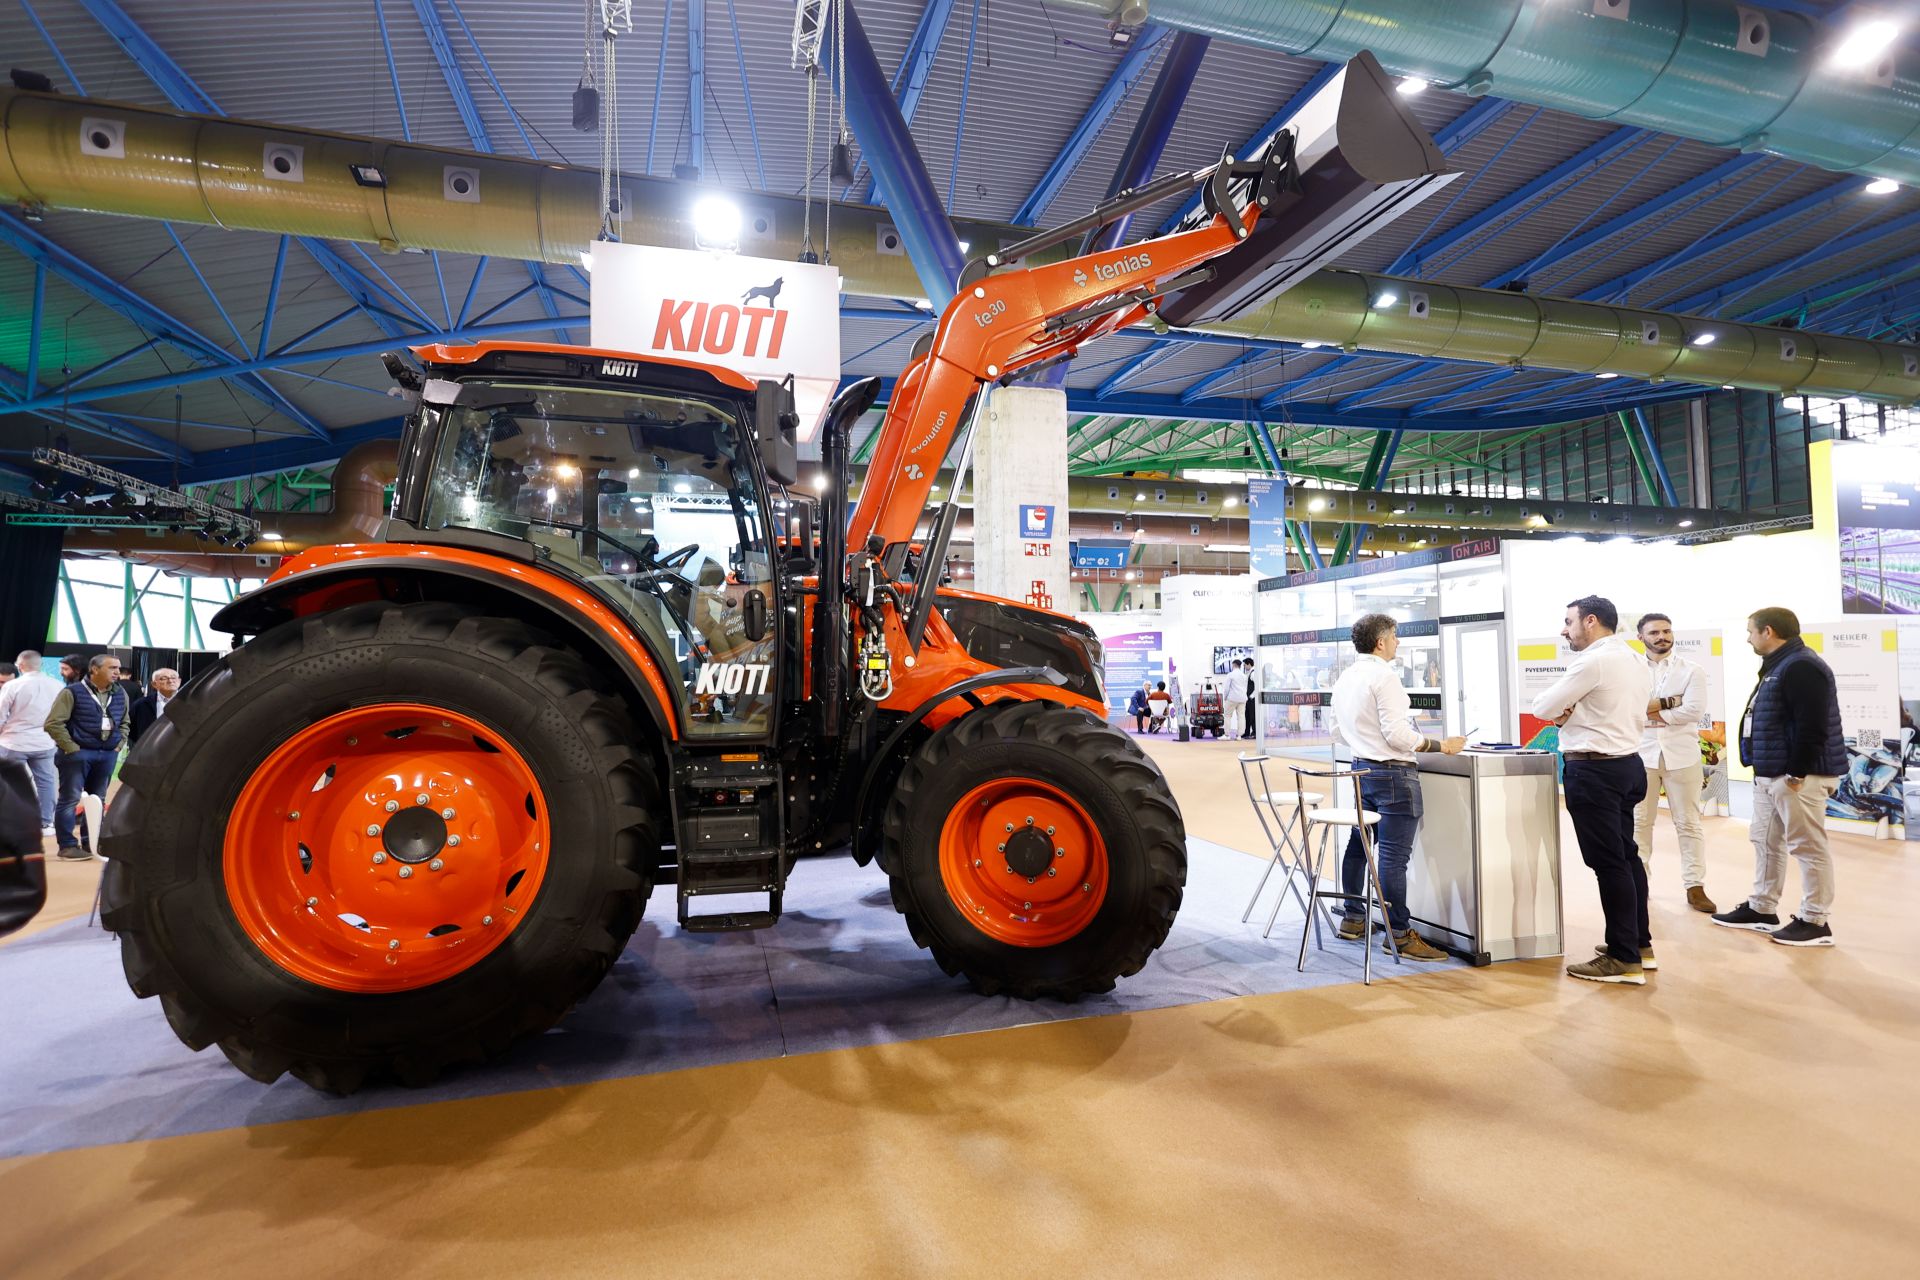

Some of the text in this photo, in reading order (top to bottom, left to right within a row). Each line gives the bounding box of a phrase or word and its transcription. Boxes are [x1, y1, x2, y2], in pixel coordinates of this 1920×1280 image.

[974, 299, 1006, 328] te30
[652, 299, 788, 359] KIOTI
[602, 360, 639, 378] KIOTI
[911, 410, 948, 454] evolution
[1456, 540, 1491, 559] ON AIR
[1103, 557, 1110, 566] 2
[1117, 552, 1124, 566] 1
[1415, 552, 1443, 564] STUDIO
[1364, 564, 1376, 573] ON
[1380, 560, 1392, 570] AIR
[1293, 575, 1303, 585] ON
[1304, 572, 1315, 583] AIR
[1405, 624, 1433, 635] STUDIO
[1268, 635, 1288, 643] STUDIO
[1293, 634, 1302, 643] ON
[1304, 631, 1315, 641] AIR
[695, 663, 770, 695] KIOTI
[1269, 695, 1290, 703] STUDIO
[1295, 695, 1304, 704] ON
[1306, 694, 1317, 703] AIR
[1412, 697, 1436, 706] TUDIO
